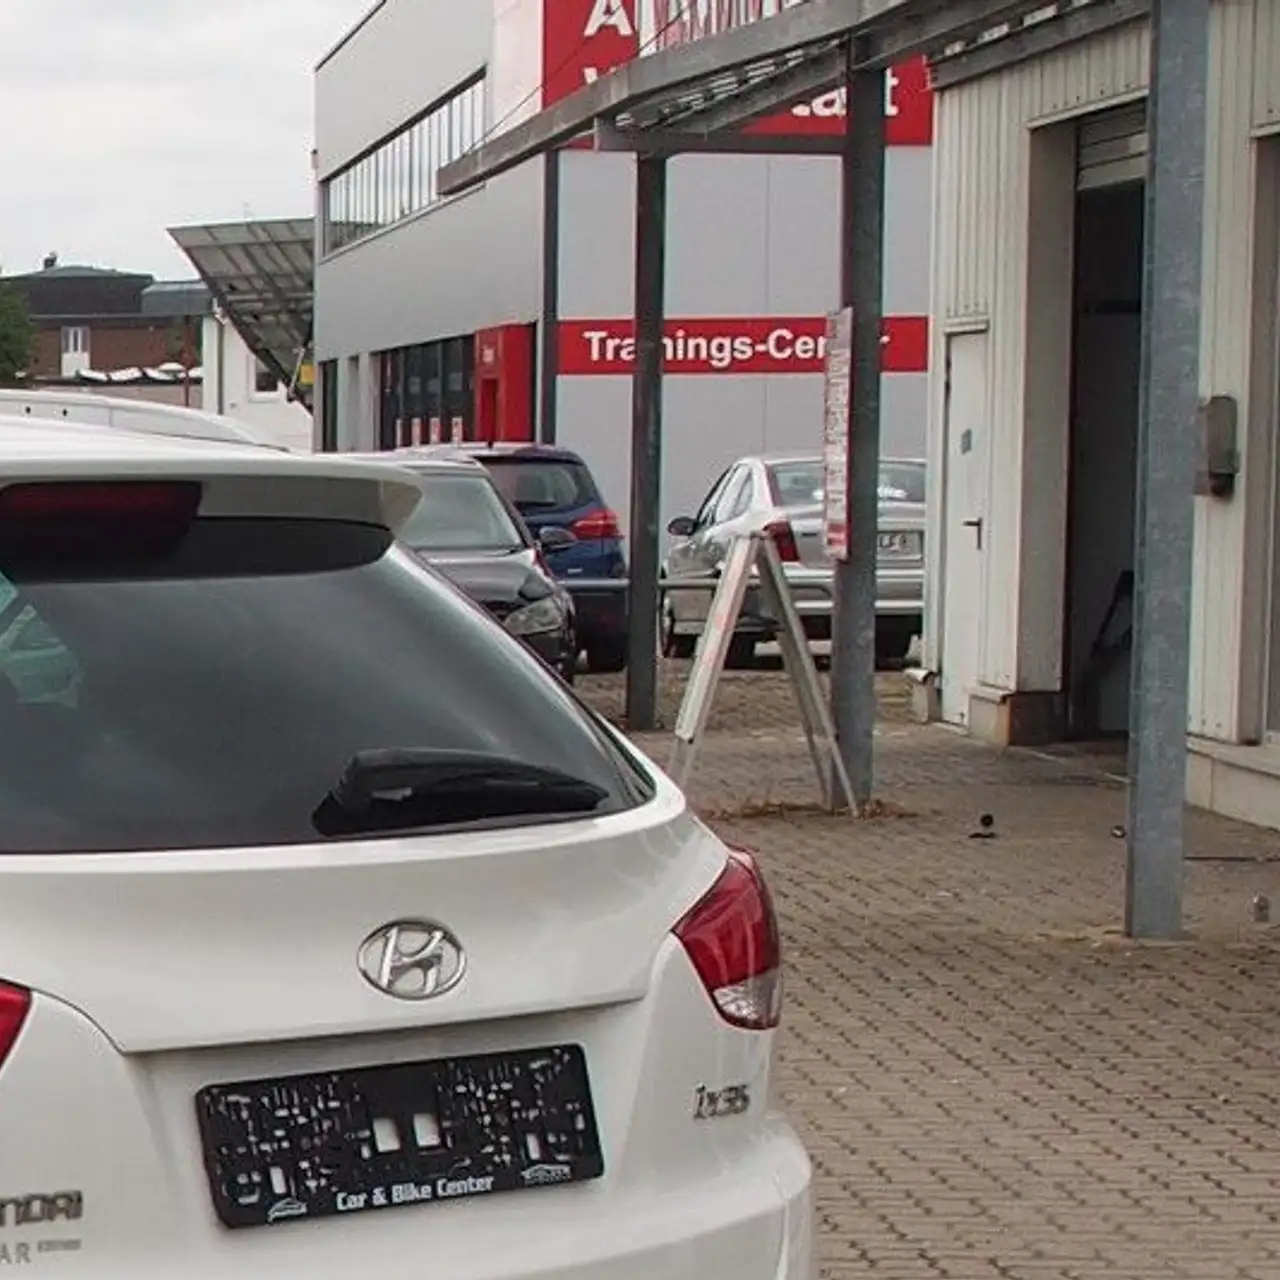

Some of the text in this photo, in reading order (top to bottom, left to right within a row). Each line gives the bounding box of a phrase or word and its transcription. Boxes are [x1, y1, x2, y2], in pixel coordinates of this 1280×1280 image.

[336, 1175, 495, 1211] Car & Bike Center
